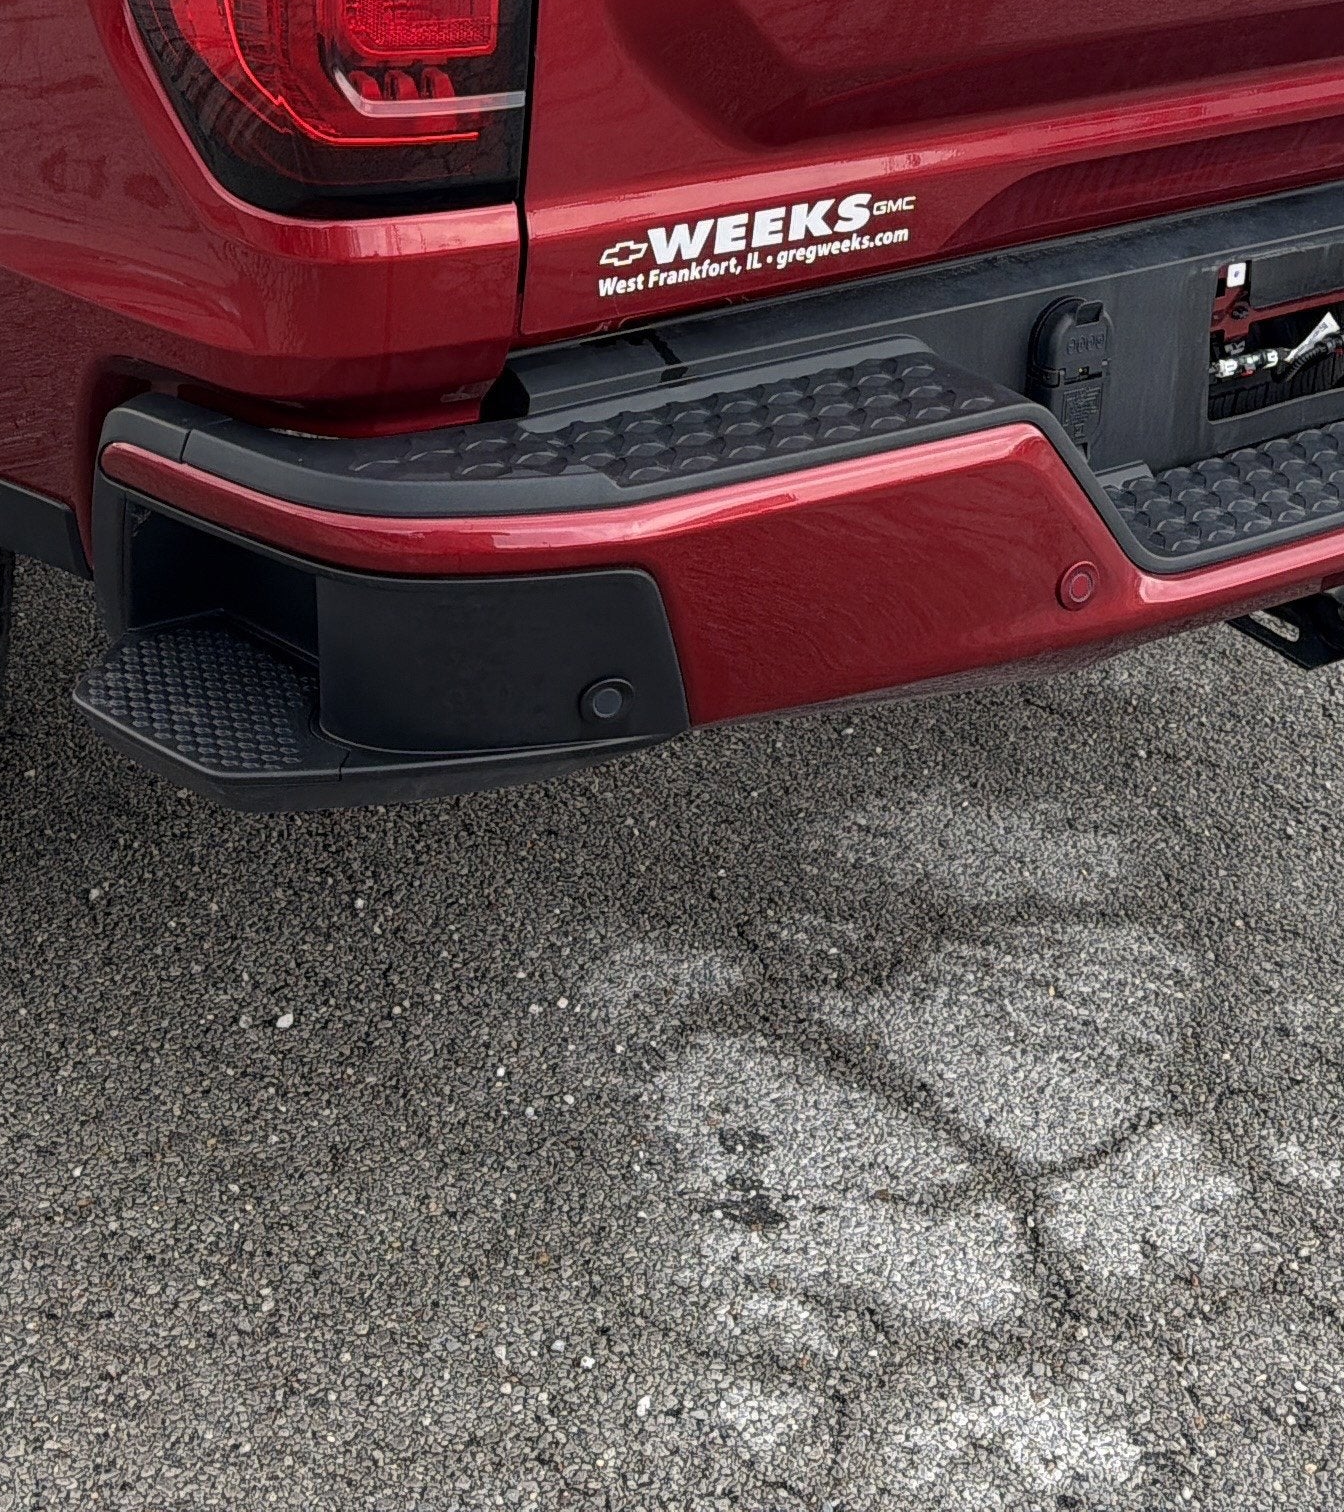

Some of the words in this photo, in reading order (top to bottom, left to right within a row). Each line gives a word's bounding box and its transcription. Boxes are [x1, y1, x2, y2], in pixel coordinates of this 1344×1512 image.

[598, 276, 645, 297] West
[647, 256, 742, 289] Frankfort,
[746, 251, 763, 271] IL
[776, 228, 909, 270] gregweeks.com
[646, 193, 873, 265] WEEKS
[872, 195, 917, 216] GMC
